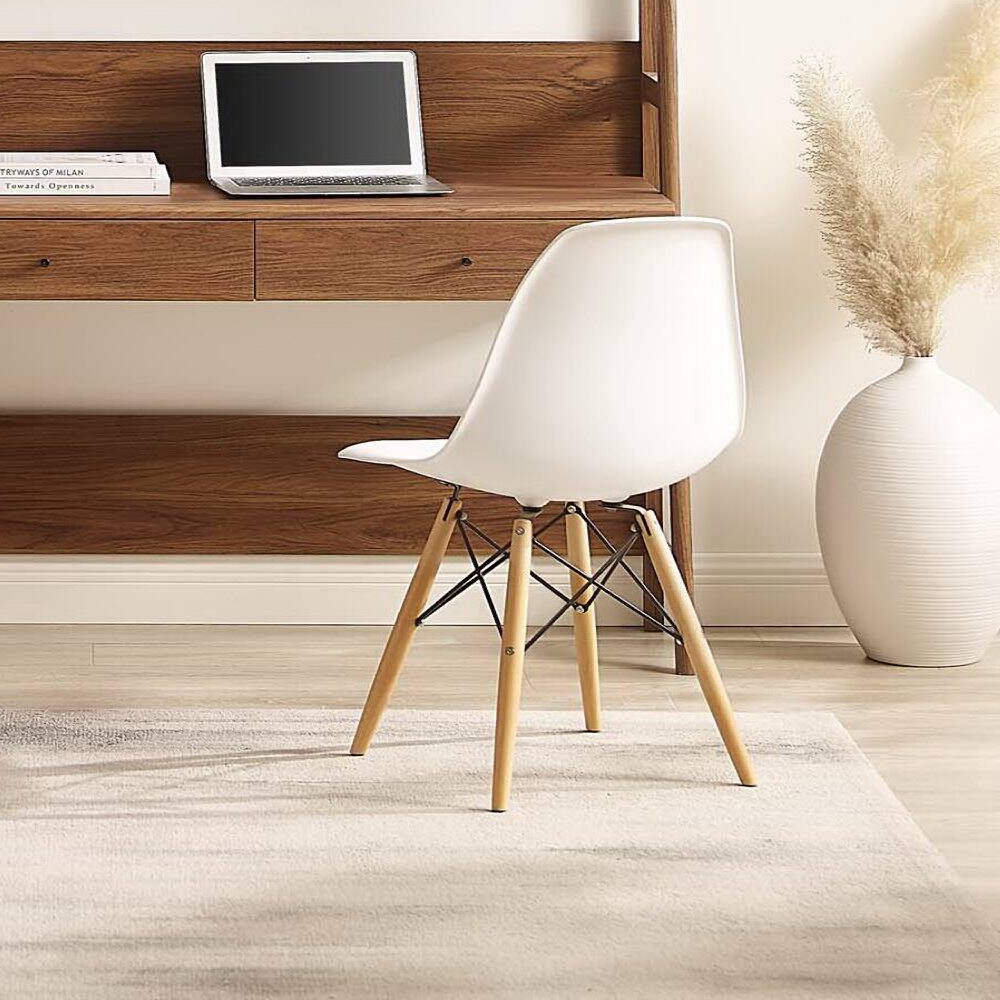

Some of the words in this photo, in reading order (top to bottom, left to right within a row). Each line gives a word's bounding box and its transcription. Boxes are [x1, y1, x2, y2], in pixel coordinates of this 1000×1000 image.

[42, 168, 54, 176] OF
[56, 168, 84, 176] MILAN
[48, 182, 95, 191] Openness
